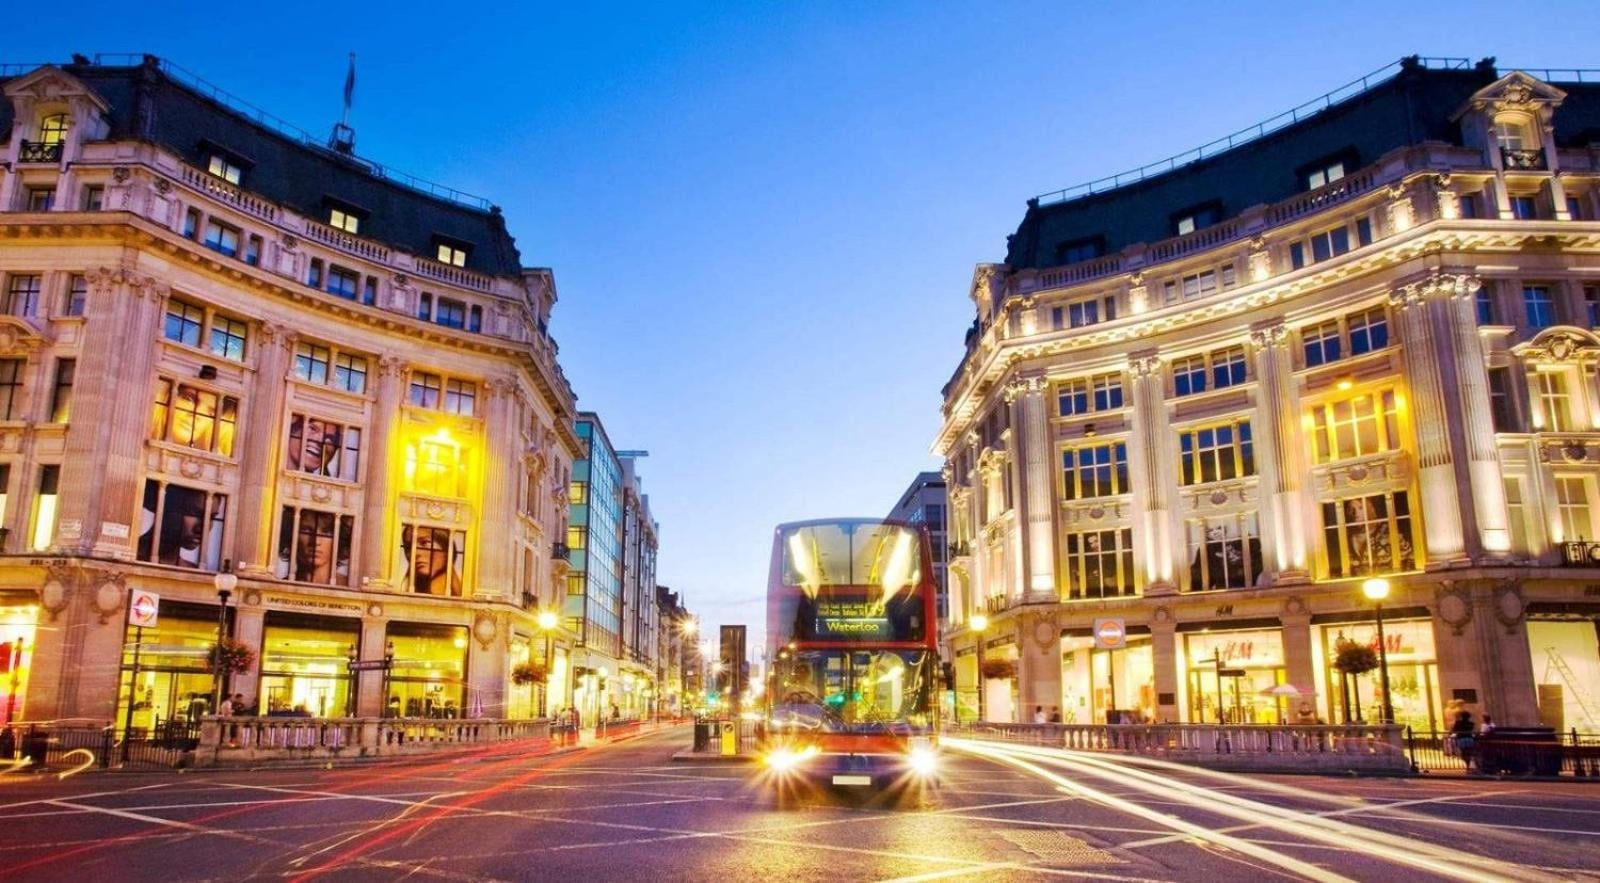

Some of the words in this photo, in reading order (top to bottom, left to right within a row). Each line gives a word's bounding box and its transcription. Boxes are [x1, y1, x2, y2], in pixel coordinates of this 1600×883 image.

[266, 596, 291, 605] UNITED
[292, 599, 318, 608] COLORS
[827, 621, 879, 632] Waterloo
